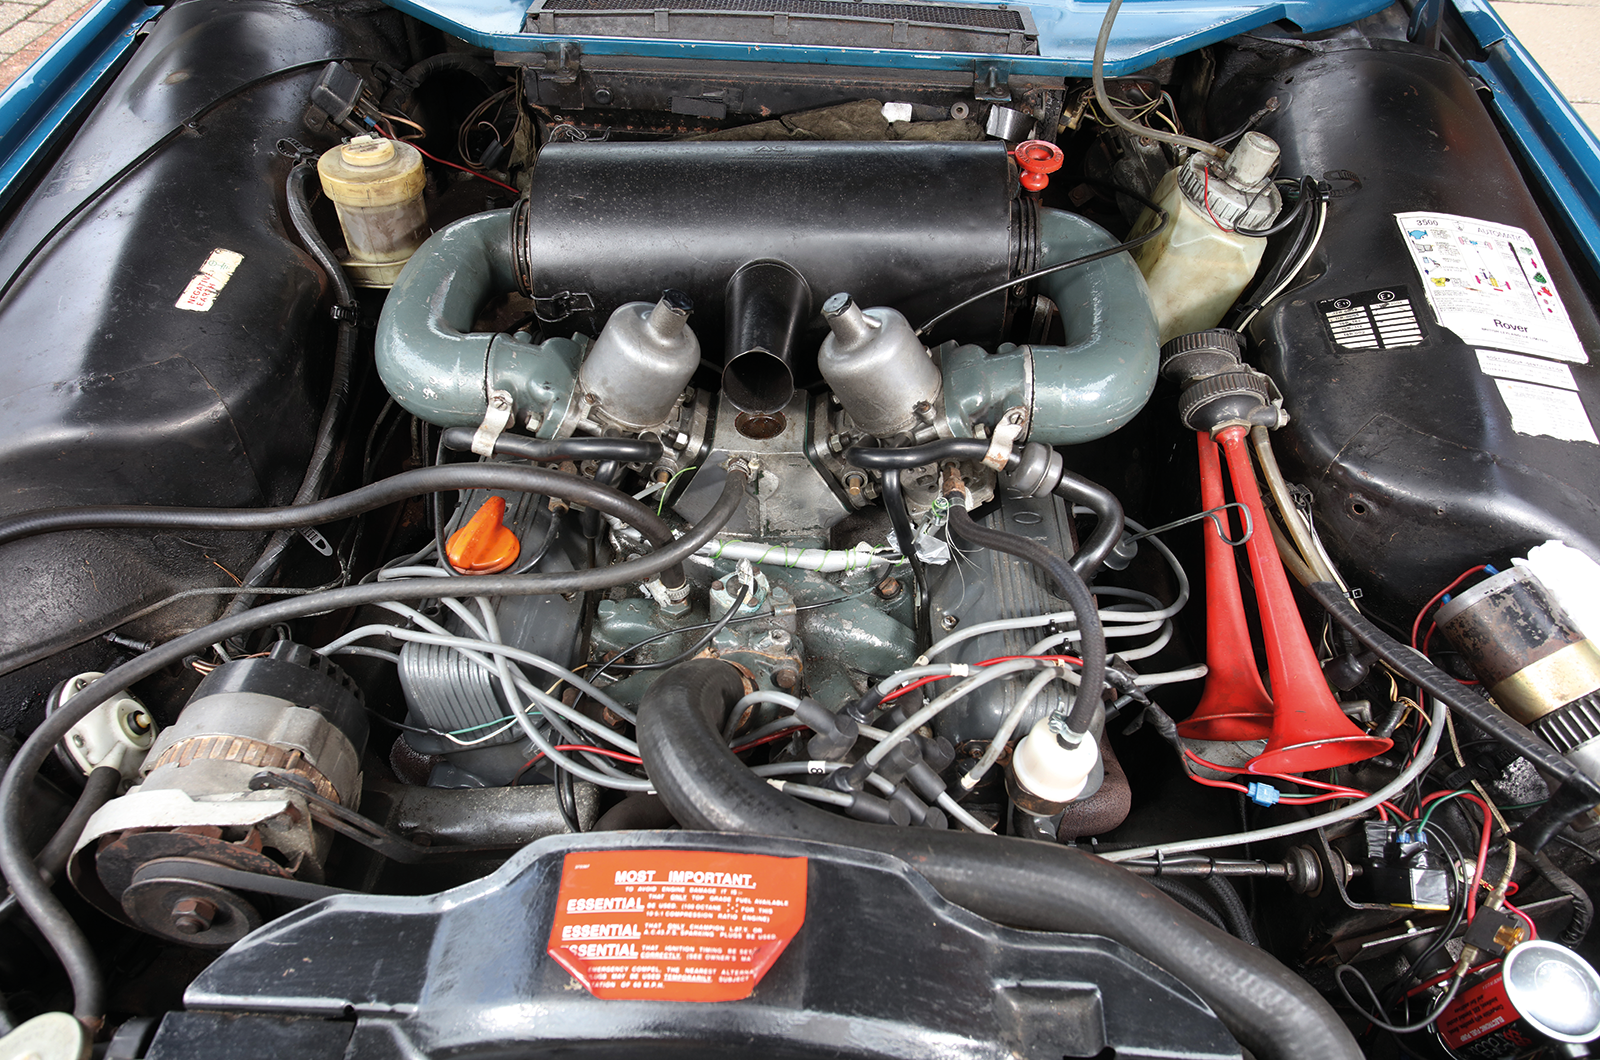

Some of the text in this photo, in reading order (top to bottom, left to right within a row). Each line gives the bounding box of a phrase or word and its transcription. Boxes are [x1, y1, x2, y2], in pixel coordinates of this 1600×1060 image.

[1477, 227, 1525, 243] AUTOMATIC
[1493, 319, 1528, 333] Rover
[614, 870, 657, 883] MOST
[567, 897, 645, 911] ESSENTIAL
[670, 893, 688, 901] ONLY
[754, 898, 789, 907] AVAILABLE
[665, 910, 714, 919] COMPRESSION
[717, 912, 738, 920] RATIO
[562, 924, 641, 938] ESSENTIAL
[667, 922, 685, 930] ONLY
[689, 923, 725, 931] CHAMPION
[680, 930, 715, 938] SPARKING
[560, 944, 639, 957] SSENTIAL
[699, 946, 722, 954] TIMING
[727, 947, 737, 955] BE
[685, 967, 717, 975] NEAREST
